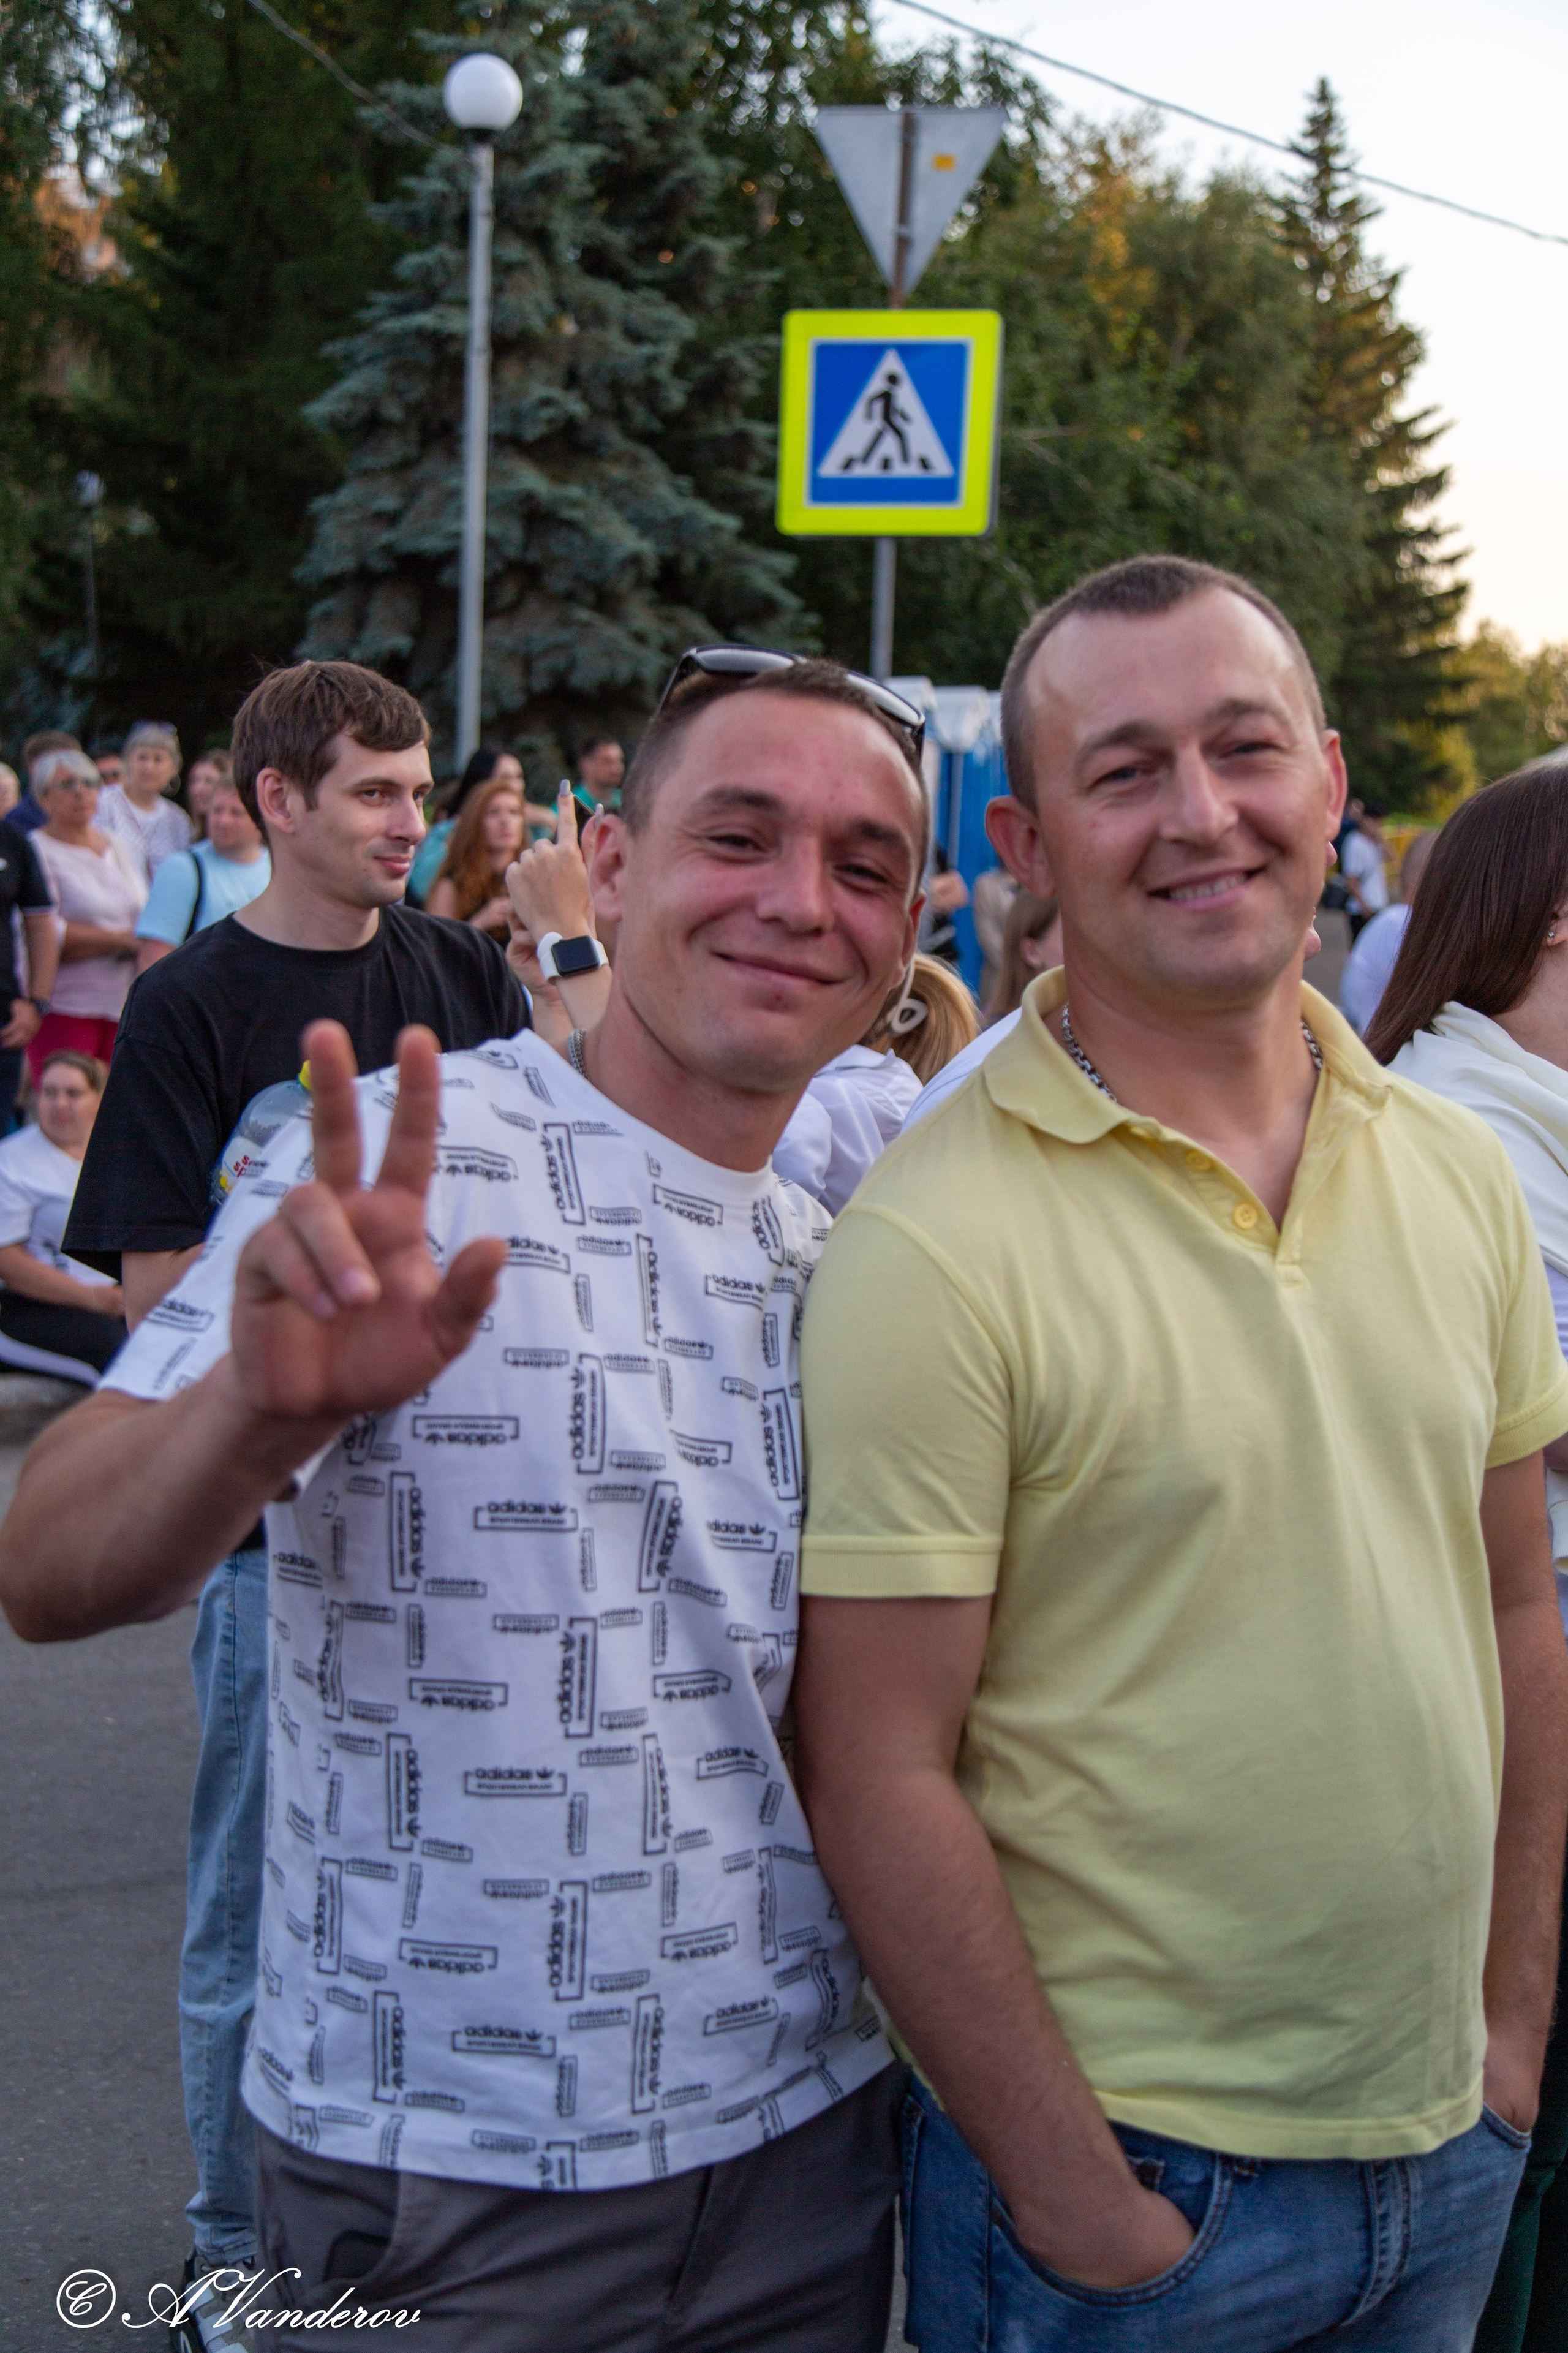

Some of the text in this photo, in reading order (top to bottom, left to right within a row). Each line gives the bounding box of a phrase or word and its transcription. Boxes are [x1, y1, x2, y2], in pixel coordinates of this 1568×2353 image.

[464, 1164, 511, 1182] adidas
[546, 1155, 566, 1210] adidas
[676, 1209, 715, 1226] adidas
[648, 1251, 660, 1313] adidas
[712, 1274, 753, 1290] adidas
[571, 1391, 586, 1459] adidas
[448, 1433, 505, 1447] adidas
[763, 1425, 779, 1487] adidas
[487, 1500, 545, 1514] adidas
[410, 1487, 424, 1553] adidas
[658, 1496, 684, 1556] adidas
[556, 1656, 575, 1724] adidas
[680, 1684, 719, 1701] adidas
[442, 1694, 496, 1712] adidas
[704, 1745, 741, 1762] adidas
[405, 1748, 424, 1815] adidas
[475, 1766, 533, 1780] adidas
[313, 1892, 327, 1958] adidas
[547, 1920, 566, 1989] adidas
[688, 1939, 732, 1960] adidas
[431, 1957, 484, 1974] adidas
[715, 1998, 758, 2020] adidas
[391, 2005, 407, 2069] adidas
[464, 2024, 522, 2040] adidas
[650, 2006, 664, 2073] adidas
